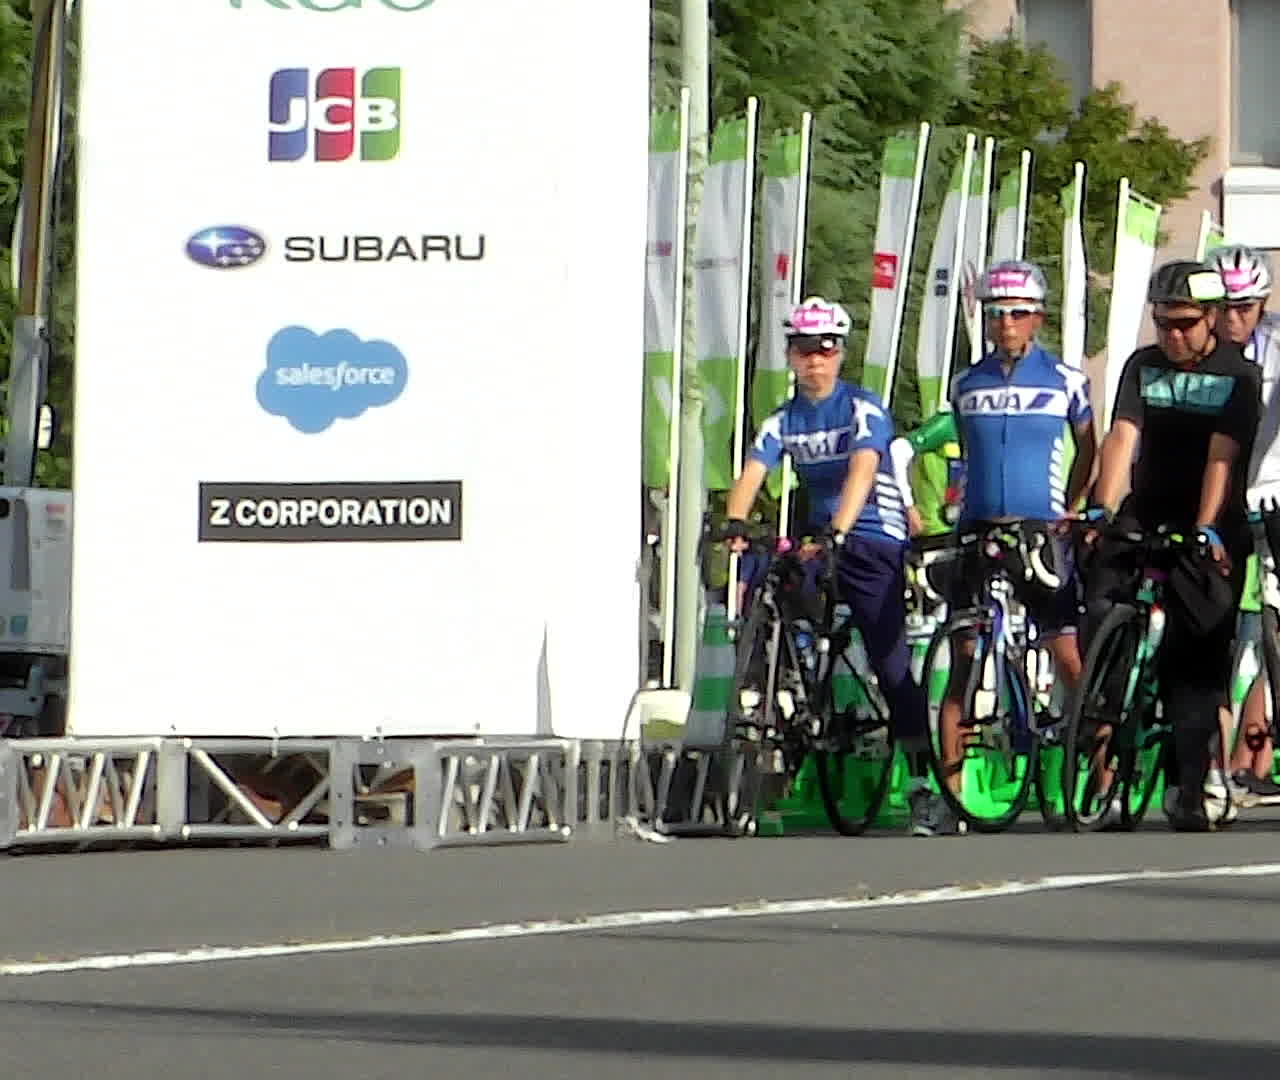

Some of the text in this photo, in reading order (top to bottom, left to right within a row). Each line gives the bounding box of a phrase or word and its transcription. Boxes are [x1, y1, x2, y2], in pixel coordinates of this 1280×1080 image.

[284, 233, 487, 263] SUBARU
[276, 360, 396, 391] salesforce
[210, 497, 451, 526] Z CORPORATION
